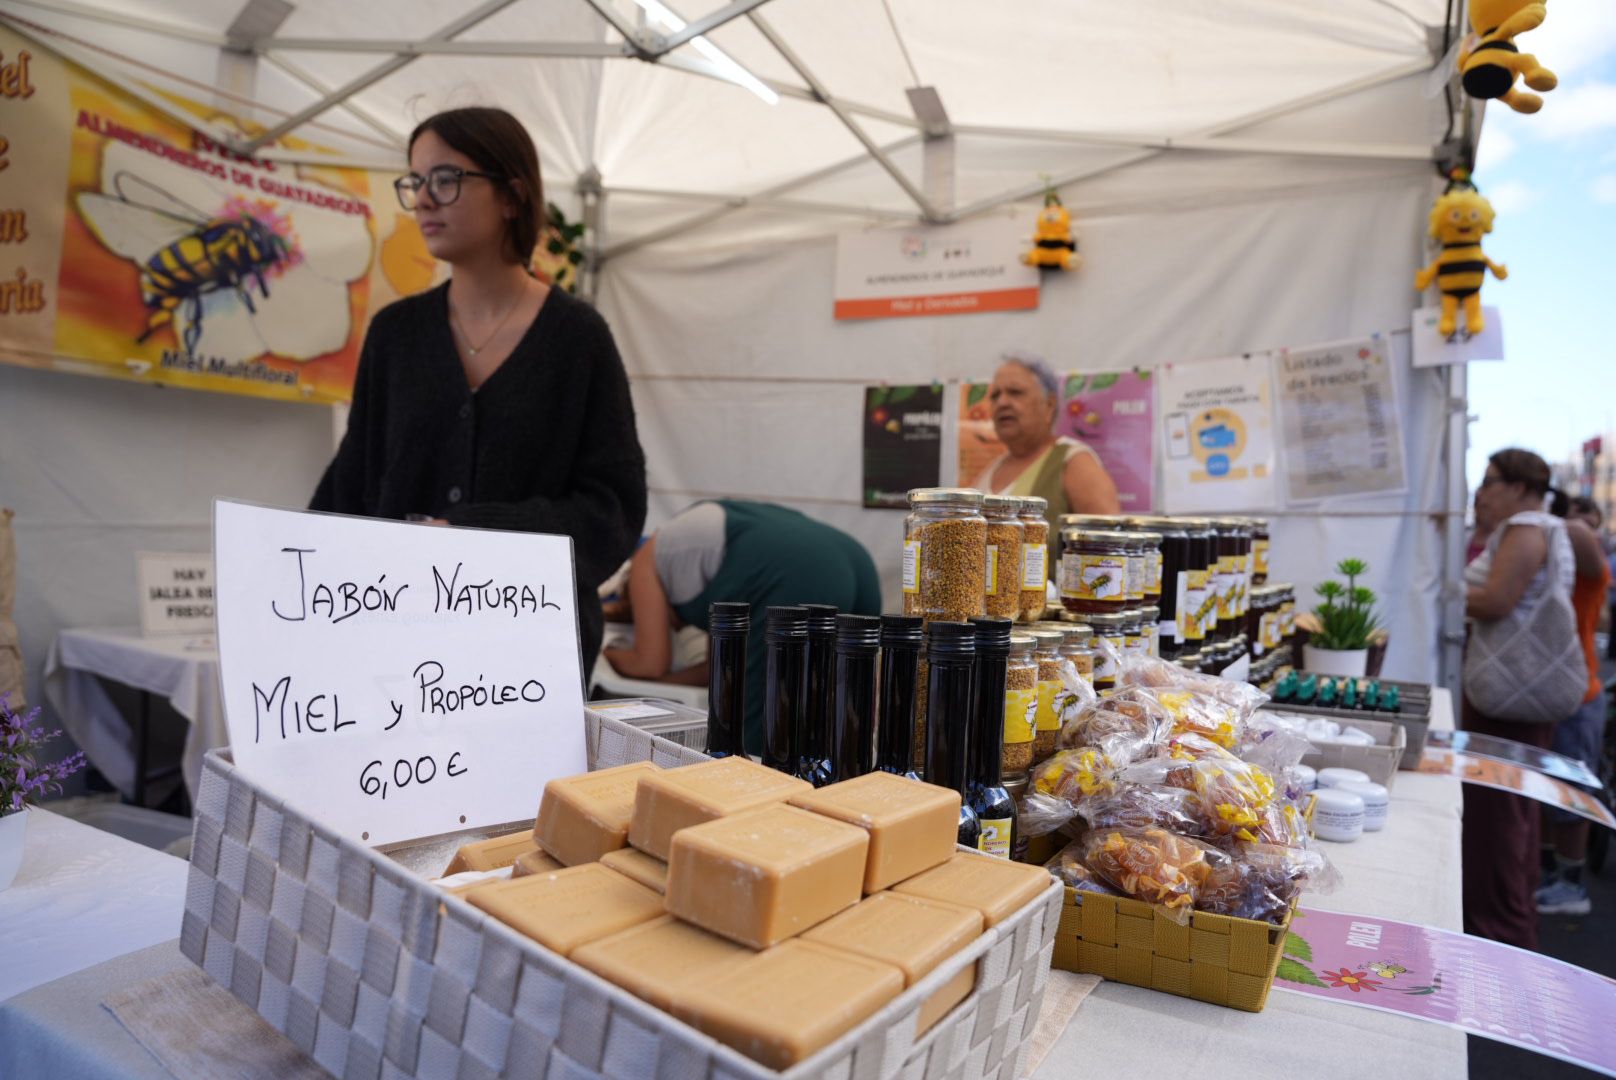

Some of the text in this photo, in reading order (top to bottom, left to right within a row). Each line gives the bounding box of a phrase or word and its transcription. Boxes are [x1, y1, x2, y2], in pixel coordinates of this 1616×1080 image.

[173, 569, 206, 580] HAY
[272, 548, 561, 623] JABÓN NATURAL
[197, 587, 212, 599] RE
[253, 676, 356, 743] MIEL
[413, 661, 545, 714] PROPÓLEO
[1345, 921, 1382, 950] POLEN
